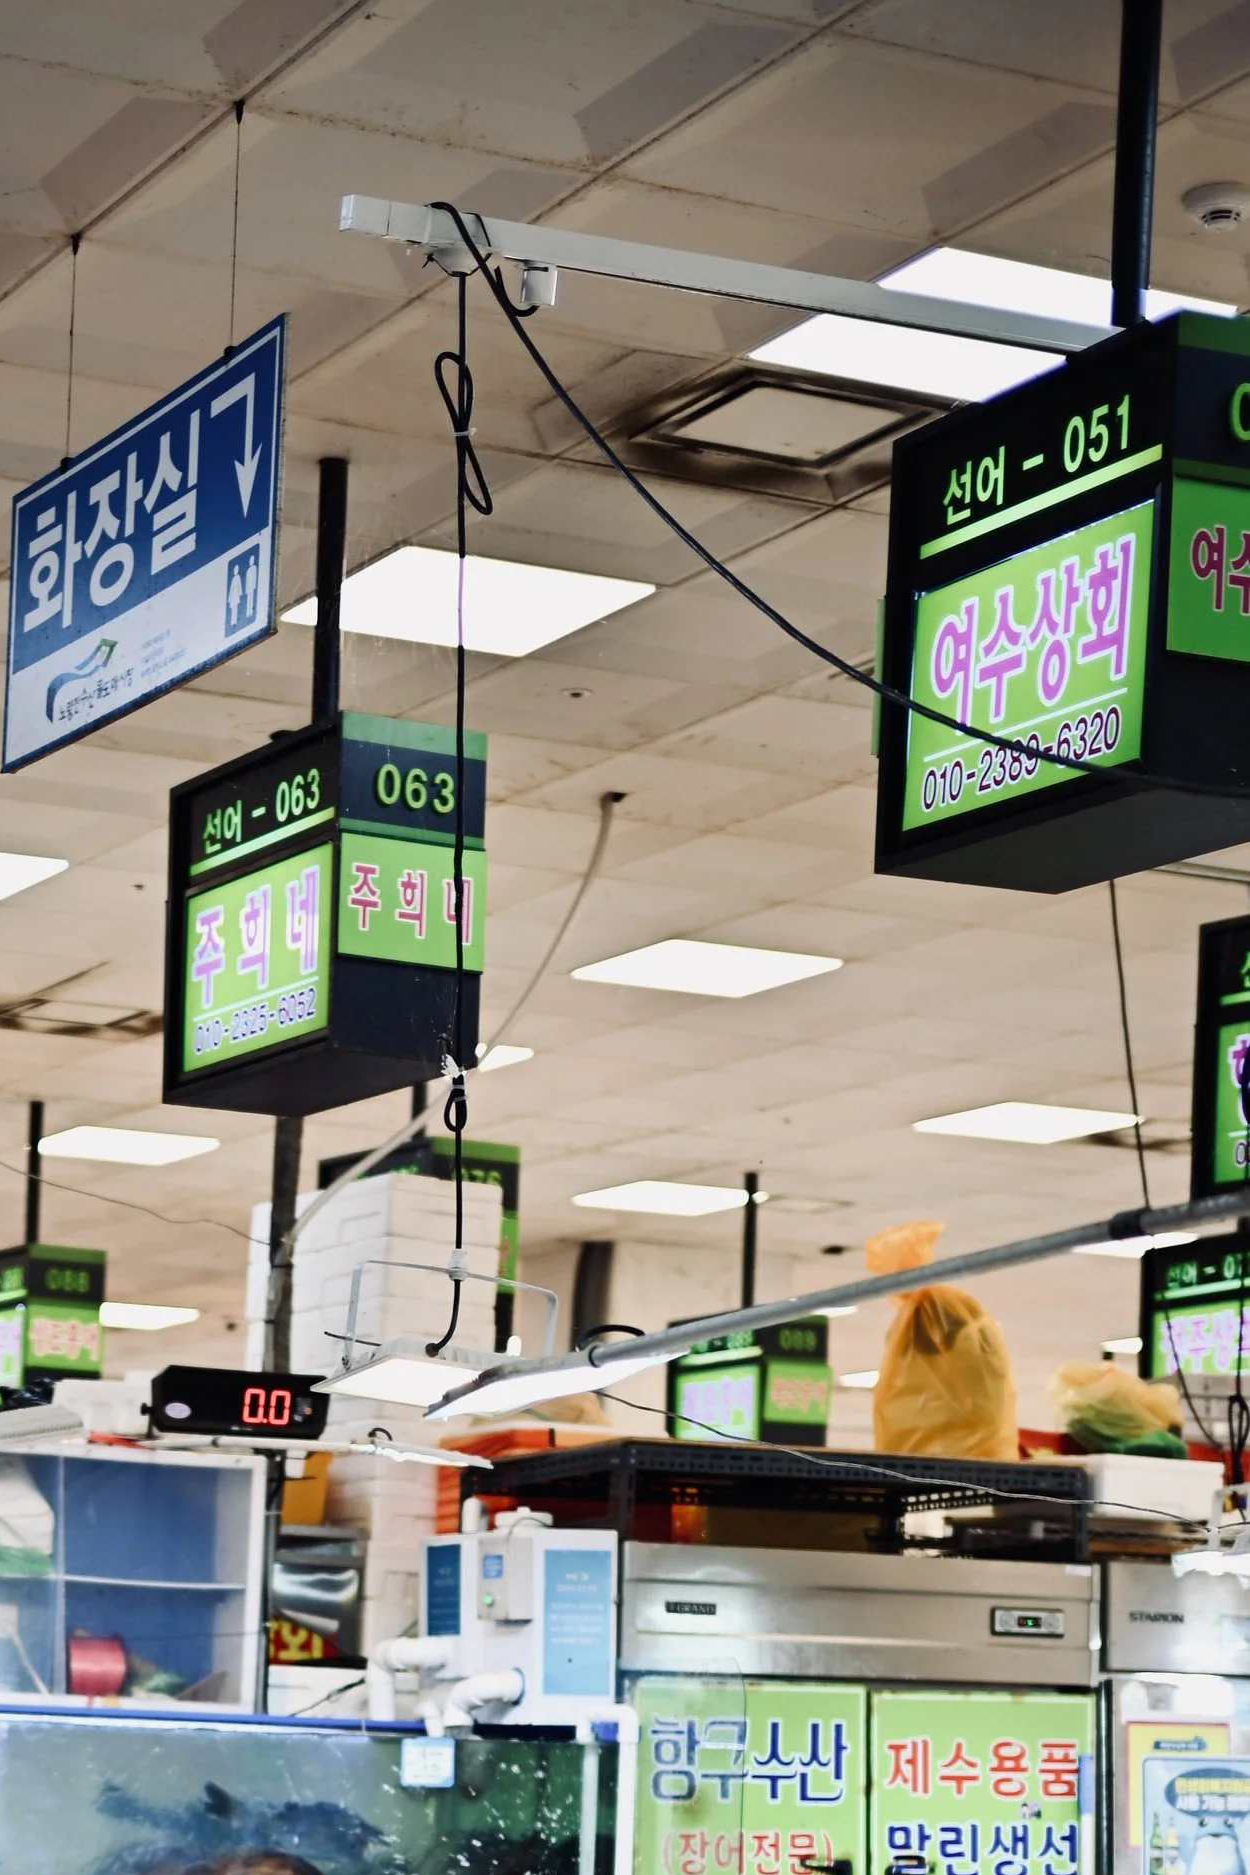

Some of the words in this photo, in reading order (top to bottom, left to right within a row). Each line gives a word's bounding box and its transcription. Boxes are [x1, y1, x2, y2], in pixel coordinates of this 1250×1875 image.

[942, 446, 1007, 524] 선어
[1063, 394, 1131, 471] 051
[23, 410, 200, 634] 화장실
[930, 533, 1136, 736] 여수상회
[203, 799, 243, 853] 선어
[275, 768, 321, 823] 063
[376, 763, 455, 814] 063
[192, 864, 321, 1009] 주희네
[348, 862, 474, 946] 주희네
[242, 1387, 291, 1425] 0.0
[1129, 1611, 1184, 1624] STARION
[651, 1716, 848, 1802] 항구수산
[887, 1739, 1079, 1796] 제수용품
[663, 1832, 833, 1875] (장어전문)
